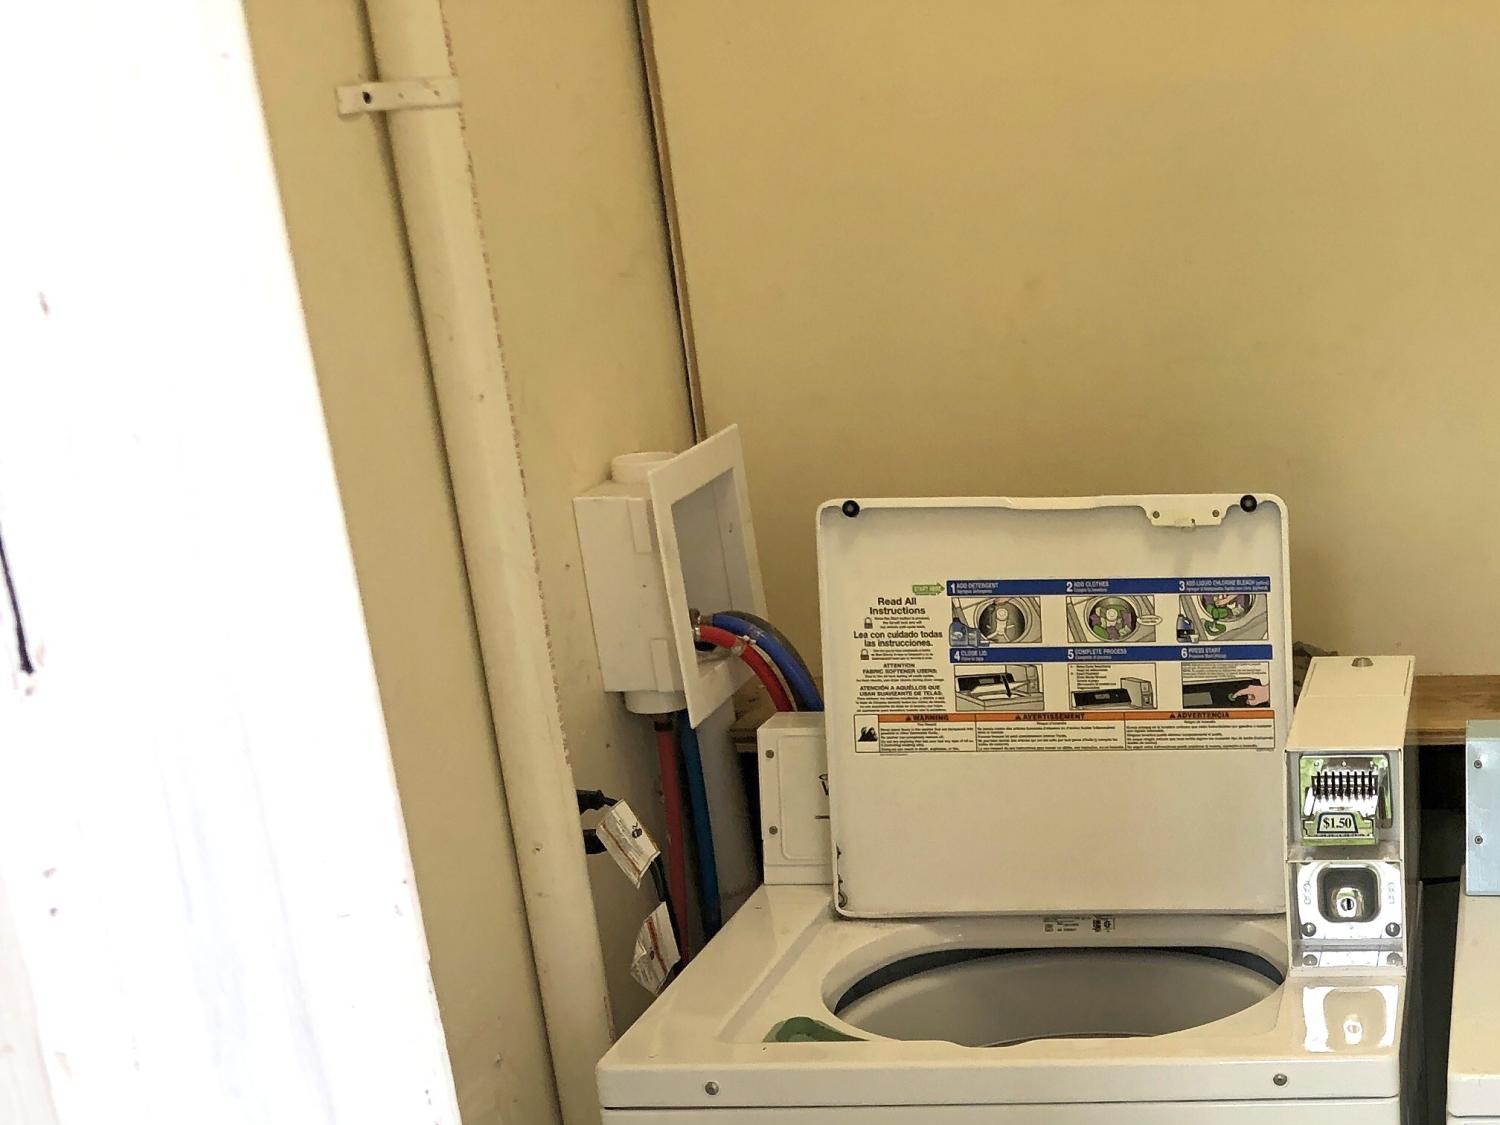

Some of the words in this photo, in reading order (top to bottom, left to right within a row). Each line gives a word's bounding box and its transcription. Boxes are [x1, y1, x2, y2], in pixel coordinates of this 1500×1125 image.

[950, 583, 956, 594] 1
[1066, 581, 1073, 593] 2
[1179, 580, 1185, 591] 3
[878, 597, 902, 606] Read
[905, 597, 917, 606] All
[869, 606, 926, 615] Instructions
[853, 631, 868, 639] Lea
[887, 631, 919, 639] cuidado
[920, 630, 943, 638] todas
[864, 639, 876, 647] las
[878, 639, 933, 647] instrucciones.
[953, 650, 960, 661] 4
[1067, 649, 1074, 660] 5
[1181, 648, 1188, 658] 6
[1323, 817, 1352, 829] $1.50
